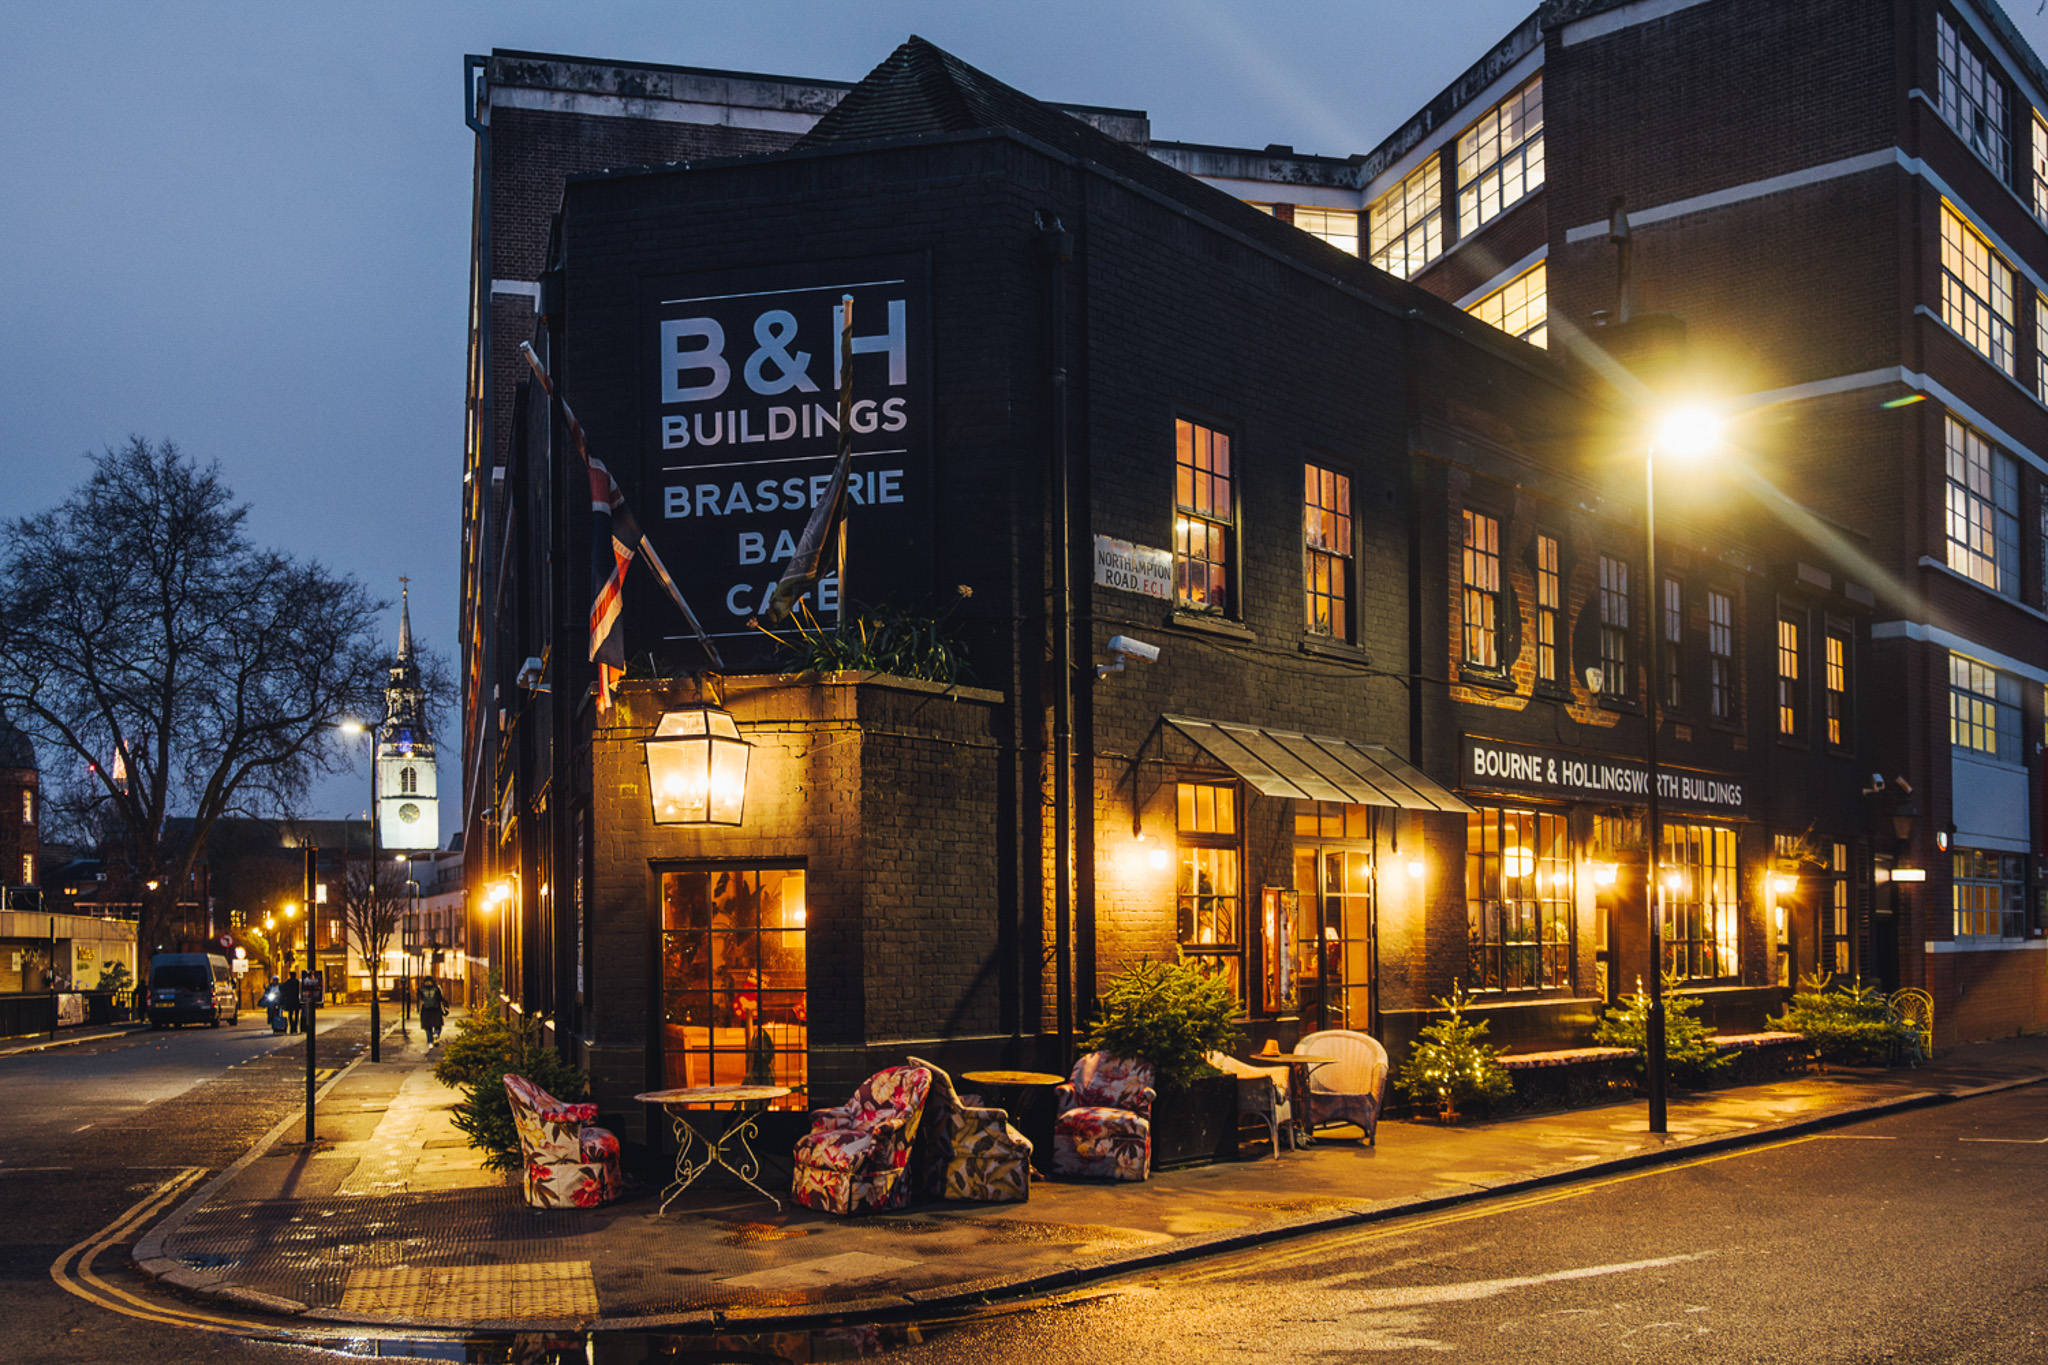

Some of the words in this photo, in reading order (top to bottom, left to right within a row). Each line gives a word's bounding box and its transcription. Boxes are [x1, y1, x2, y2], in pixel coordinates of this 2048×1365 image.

[661, 397, 908, 450] BUILDINGS
[663, 469, 904, 519] BRASSERIE
[738, 529, 798, 566] BA
[1098, 550, 1171, 580] NORTHAMPTON
[1473, 747, 1543, 782] BOURNE
[1546, 758, 1559, 784] &
[1681, 777, 1742, 806] BUILDINGS
